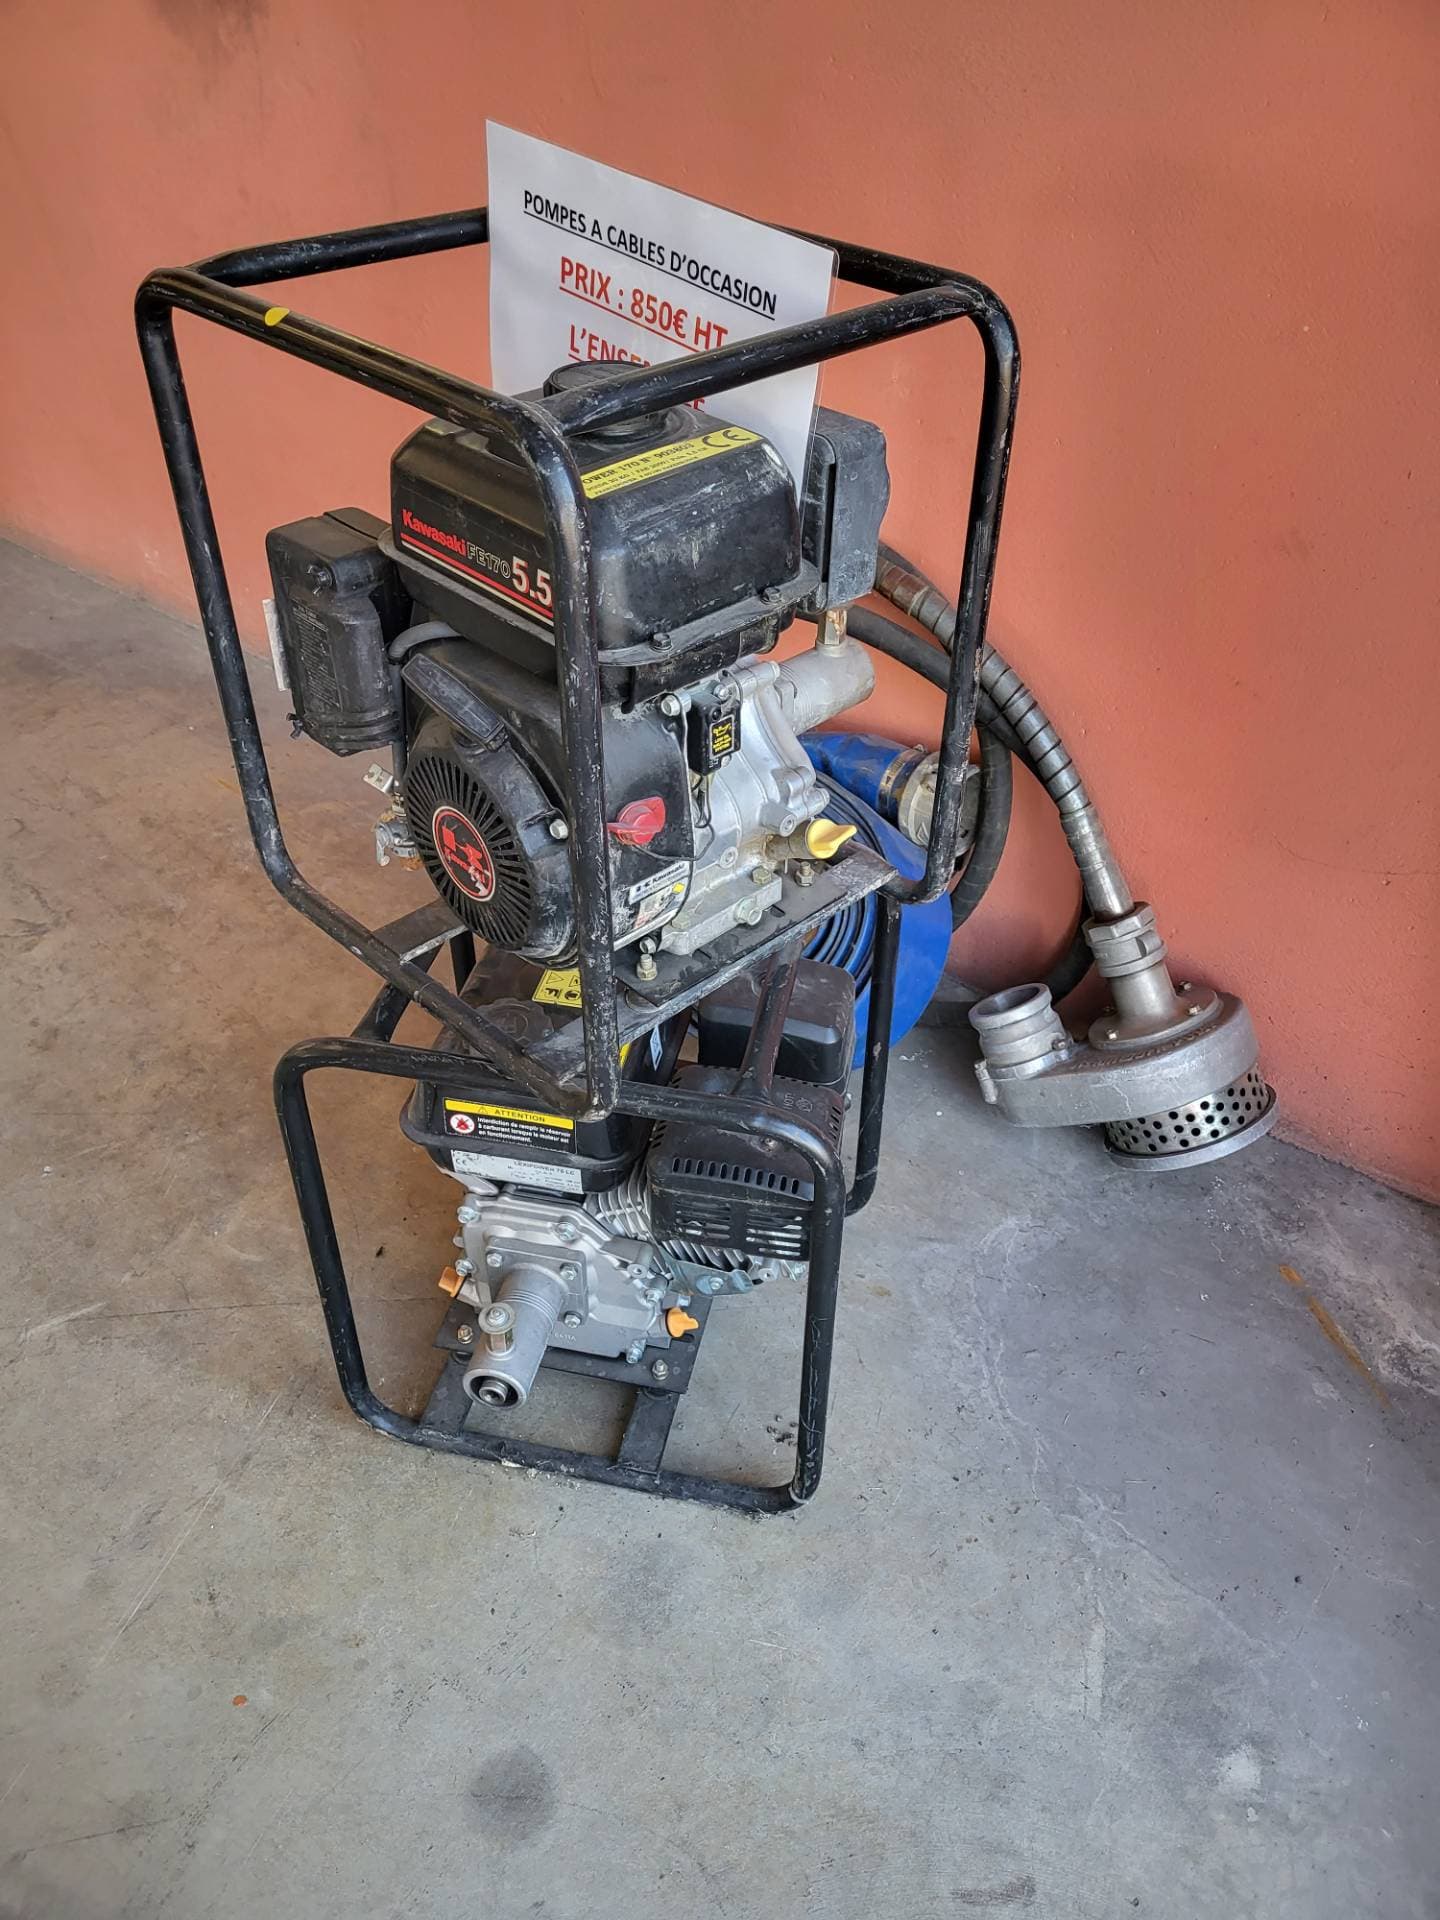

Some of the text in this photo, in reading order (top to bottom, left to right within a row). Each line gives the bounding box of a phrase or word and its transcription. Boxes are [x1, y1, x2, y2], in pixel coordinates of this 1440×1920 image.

[524, 189, 777, 315] POMPES A CABLES D’OCCASION
[560, 256, 729, 350] PRIX : 850€ HT
[402, 509, 553, 607] Kawasaki FE170 5.5
[477, 1116, 510, 1127] Interdiction
[518, 1123, 539, 1132] remplir
[539, 1125, 545, 1133] le
[546, 1128, 571, 1137] réservoir
[482, 1124, 510, 1133] carburant
[511, 1128, 532, 1138] lorsque
[539, 1133, 560, 1141] moteur
[494, 1108, 546, 1123] ATTENTION
